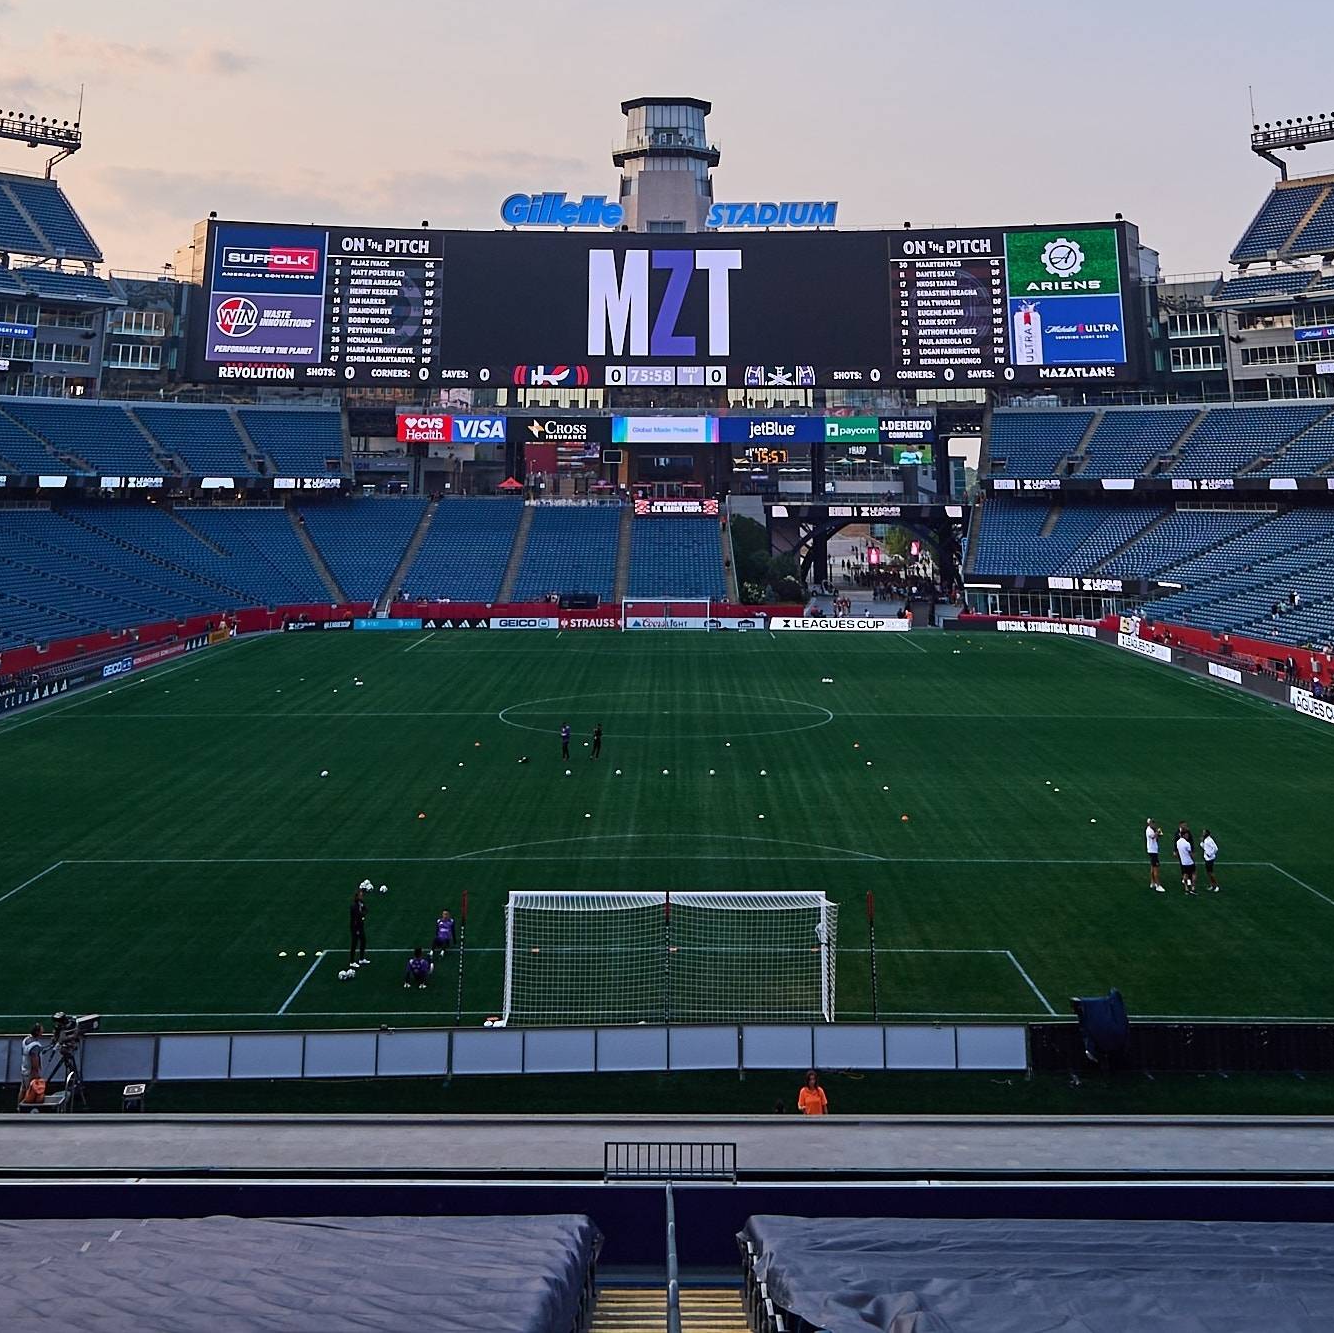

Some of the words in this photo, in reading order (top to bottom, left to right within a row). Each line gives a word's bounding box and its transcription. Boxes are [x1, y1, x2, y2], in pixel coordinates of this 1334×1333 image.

[501, 193, 623, 228] Gillette
[706, 202, 838, 227] STADIUM
[342, 237, 365, 252] ON
[367, 239, 383, 252] THE
[385, 239, 430, 254] PITCH
[903, 240, 926, 255] ON
[927, 241, 944, 254] THE
[946, 239, 992, 254] PITCH
[228, 253, 310, 265] SUFFOLK
[1027, 281, 1102, 291] ARIENS
[588, 249, 742, 356] MZT
[263, 310, 292, 319] WASTE
[348, 307, 380, 315] BRANDON
[370, 317, 390, 325] WOOD
[1085, 324, 1119, 333] ULTRA
[214, 345, 261, 354] PERFORMANCE
[262, 346, 276, 354] FOR
[276, 346, 288, 354] THE
[288, 347, 314, 355] PLANET
[1025, 327, 1035, 363] ULTRA
[218, 367, 295, 379] REVOLUTION
[306, 368, 336, 377] SHOTS:
[345, 367, 355, 379] 0
[371, 369, 411, 378] CORNERS:
[419, 368, 429, 381] 0
[441, 370, 469, 379] SAVES:
[480, 369, 490, 381] 0
[611, 369, 621, 383] 0
[630, 369, 674, 382] 75:58
[711, 369, 721, 383] 0
[834, 371, 862, 380] SHOTS:
[870, 368, 880, 382] 0
[897, 370, 936, 380] CORNERS:
[944, 368, 954, 381] 0
[967, 370, 995, 379] SAVES:
[1004, 368, 1015, 381] 0
[417, 417, 444, 428] CVS
[879, 420, 932, 431] J.DERENZO
[455, 420, 504, 438] VISA
[749, 421, 794, 439] jetBlue
[839, 426, 875, 438] paycom
[888, 431, 924, 439] COMPANIES
[499, 619, 537, 628] GEICO
[570, 618, 615, 628] STRAUSS
[794, 620, 855, 629] LEAGUES
[858, 620, 885, 629] CUP
[103, 661, 123, 677] GEICO
[4, 690, 31, 710] CLUB
